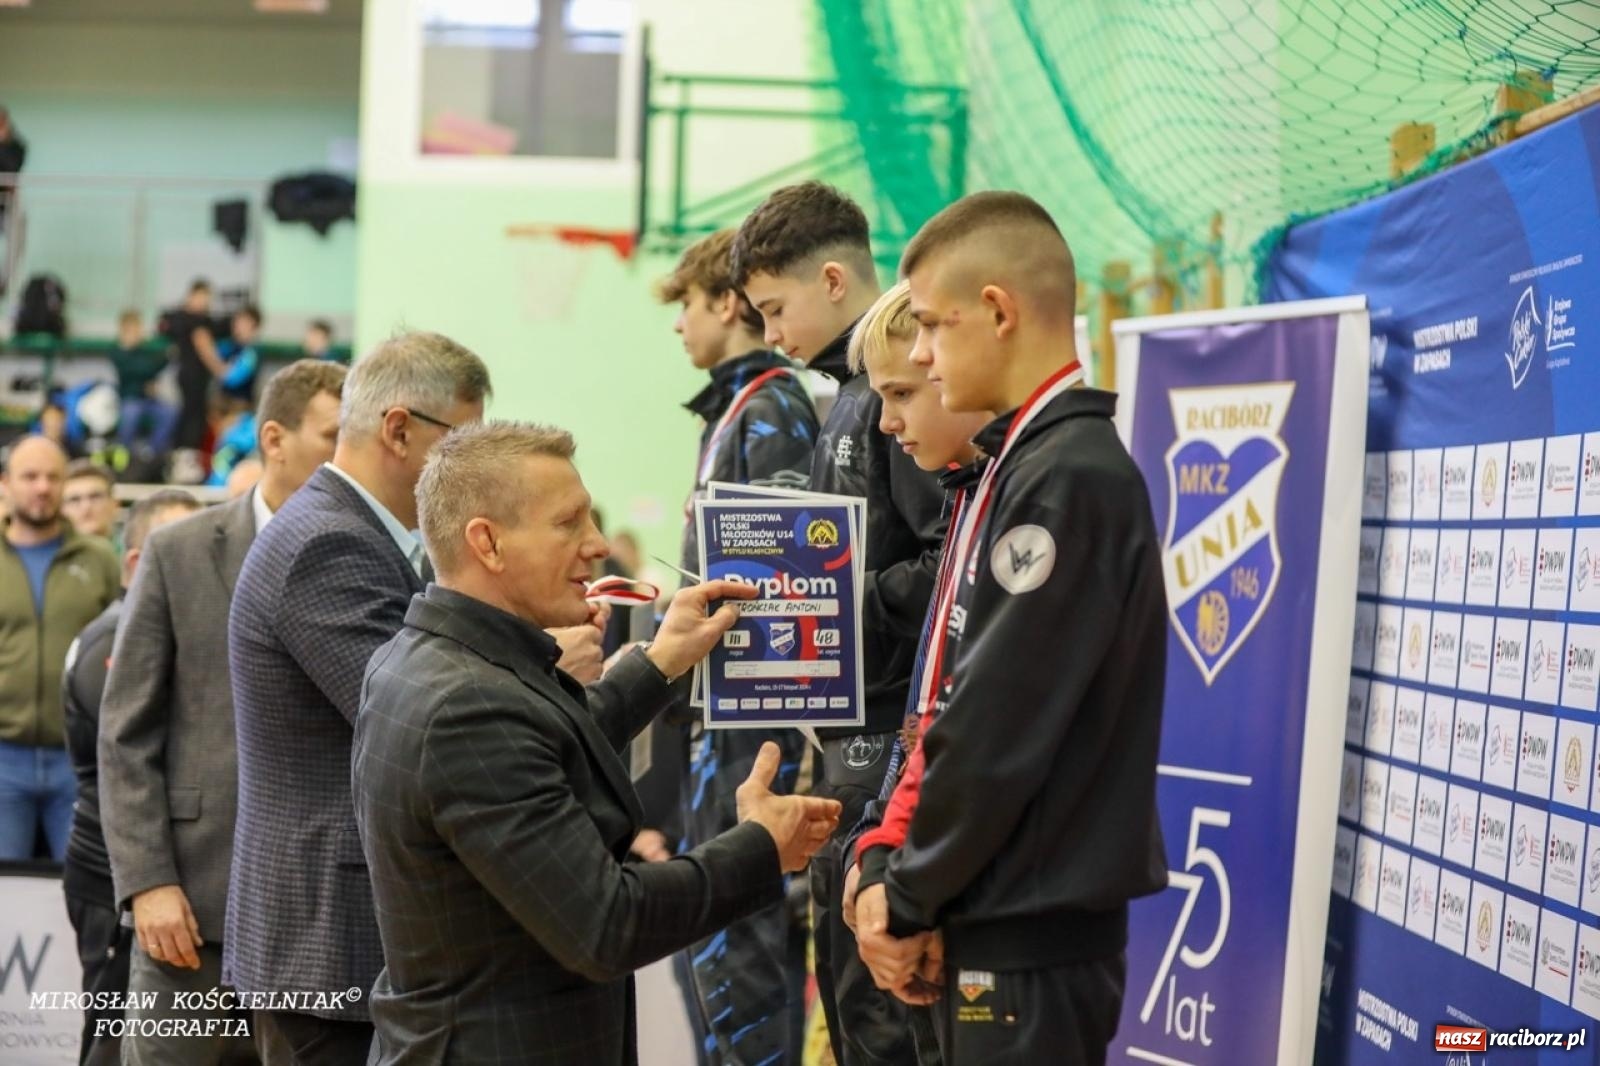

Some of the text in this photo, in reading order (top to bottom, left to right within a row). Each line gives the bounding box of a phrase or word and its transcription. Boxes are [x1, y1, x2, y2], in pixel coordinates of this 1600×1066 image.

[1186, 399, 1273, 431] RACIBÓRZ
[1179, 463, 1231, 494] MKZ
[720, 513, 782, 522] MISTRZOSTWA
[720, 522, 750, 530] POLSKI
[721, 528, 794, 539] MŁODZIKÓW U14
[722, 539, 777, 547] W ZAPASACH
[1173, 496, 1263, 590] UNIA
[1230, 566, 1260, 601] 1946
[785, 601, 822, 613] ANTONI
[815, 630, 833, 645] 48
[1140, 806, 1231, 1023] 75
[1165, 975, 1215, 1047] lat
